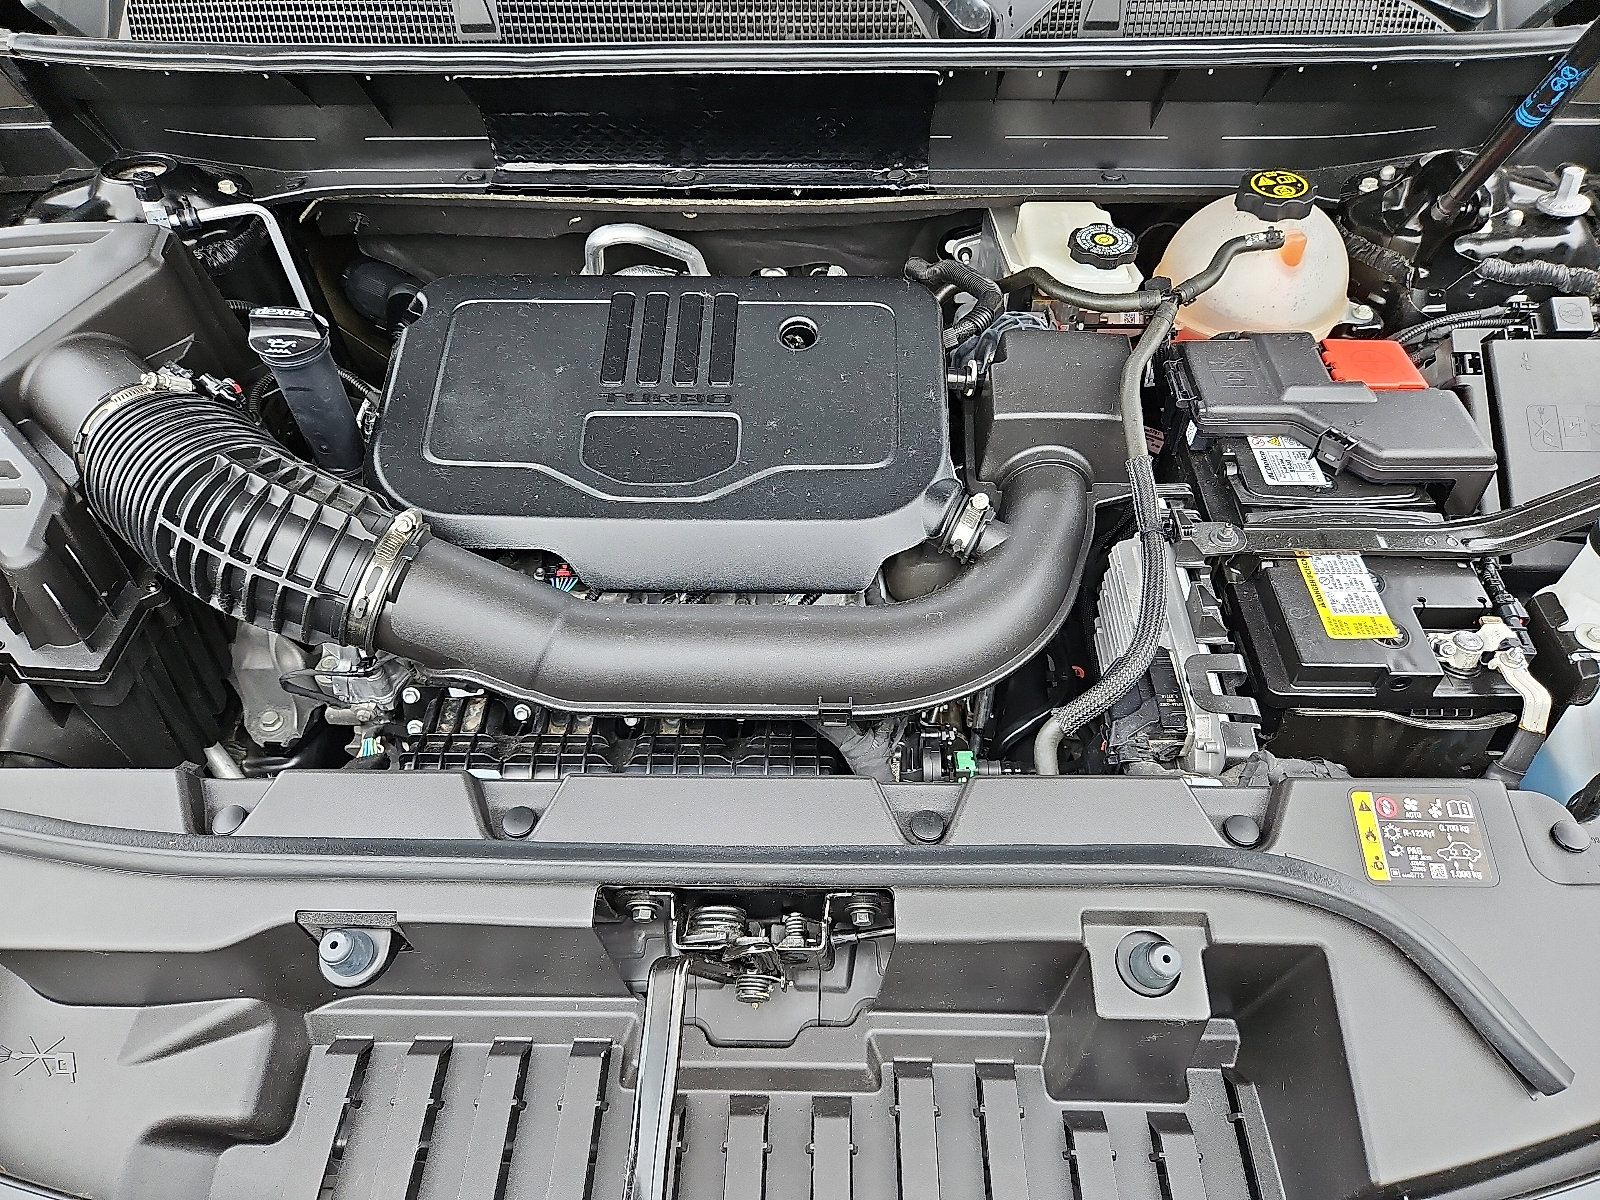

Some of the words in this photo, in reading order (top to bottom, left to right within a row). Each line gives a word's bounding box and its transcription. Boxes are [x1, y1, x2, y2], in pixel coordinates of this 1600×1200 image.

[255, 307, 307, 317] dexos
[599, 392, 732, 405] TURBO
[1406, 846, 1422, 855] PAG
